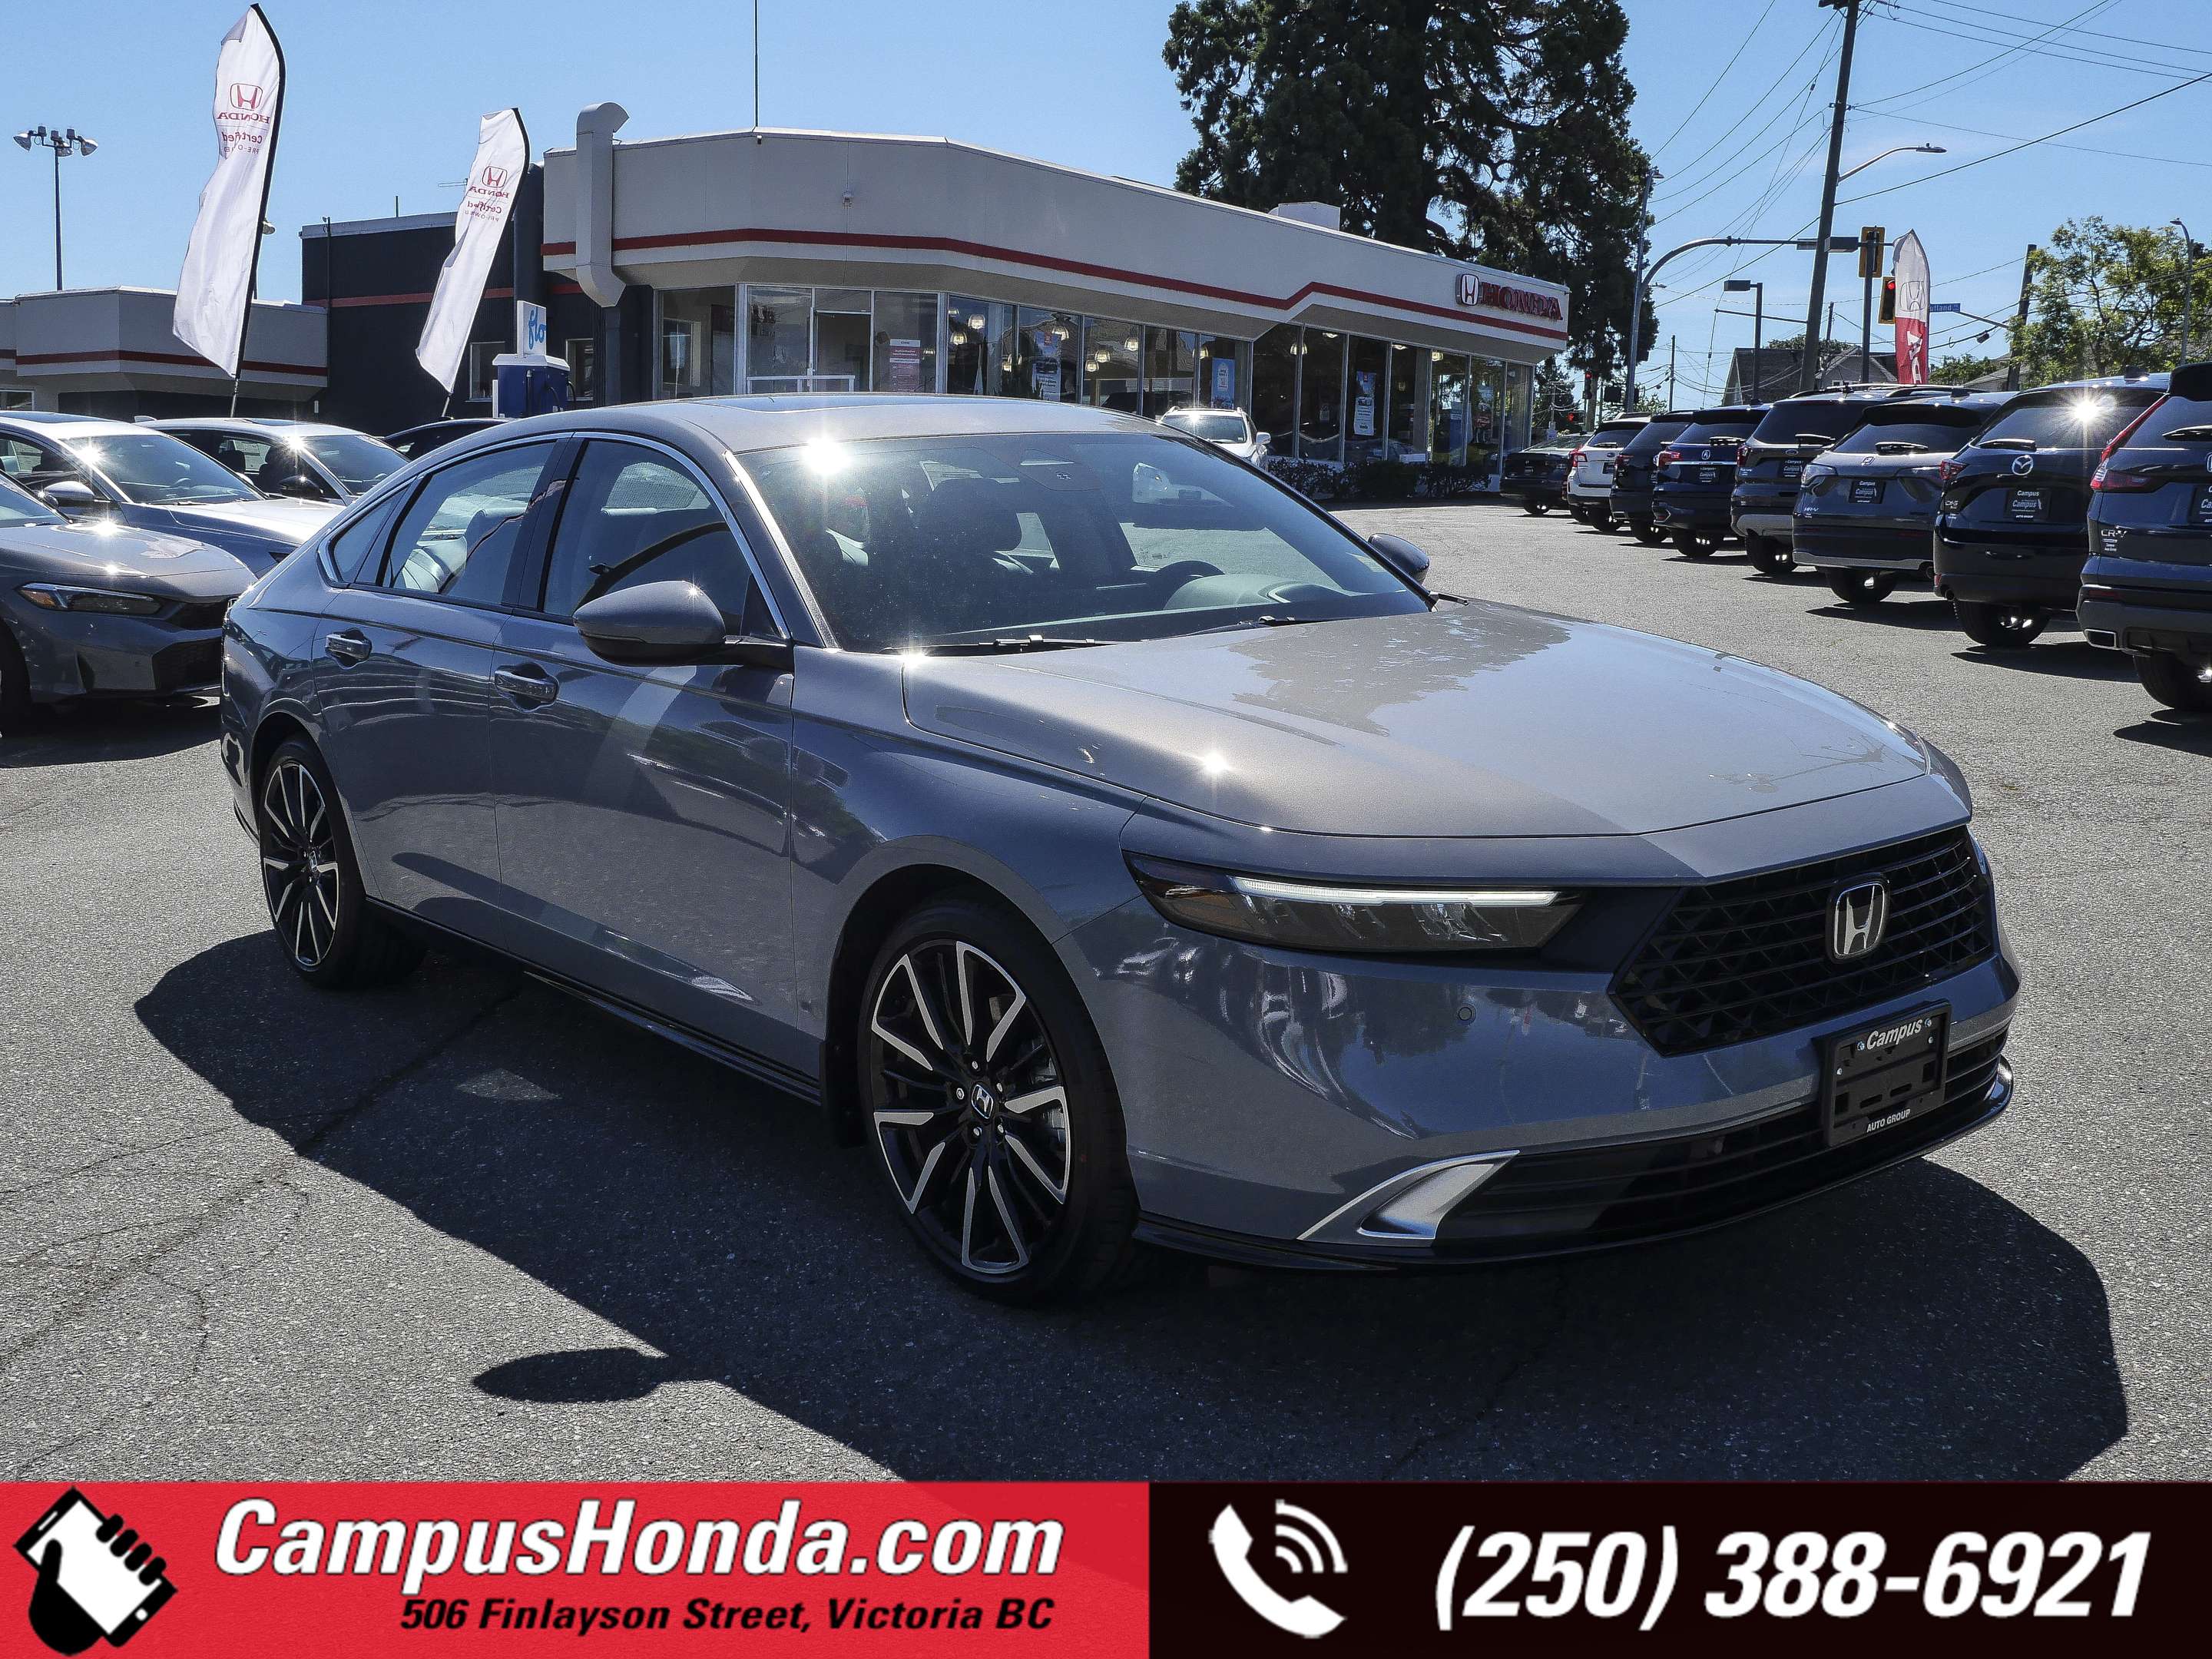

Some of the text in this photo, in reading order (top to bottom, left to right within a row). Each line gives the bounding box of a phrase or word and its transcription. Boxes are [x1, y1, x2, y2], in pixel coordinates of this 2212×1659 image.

[1481, 282, 1563, 320] HONDA
[2012, 499, 2037, 509] Campus
[2101, 529, 2128, 538] CR-V
[1866, 1019, 1923, 1051] Campus
[1866, 1108, 1911, 1133] AUTO GROUP
